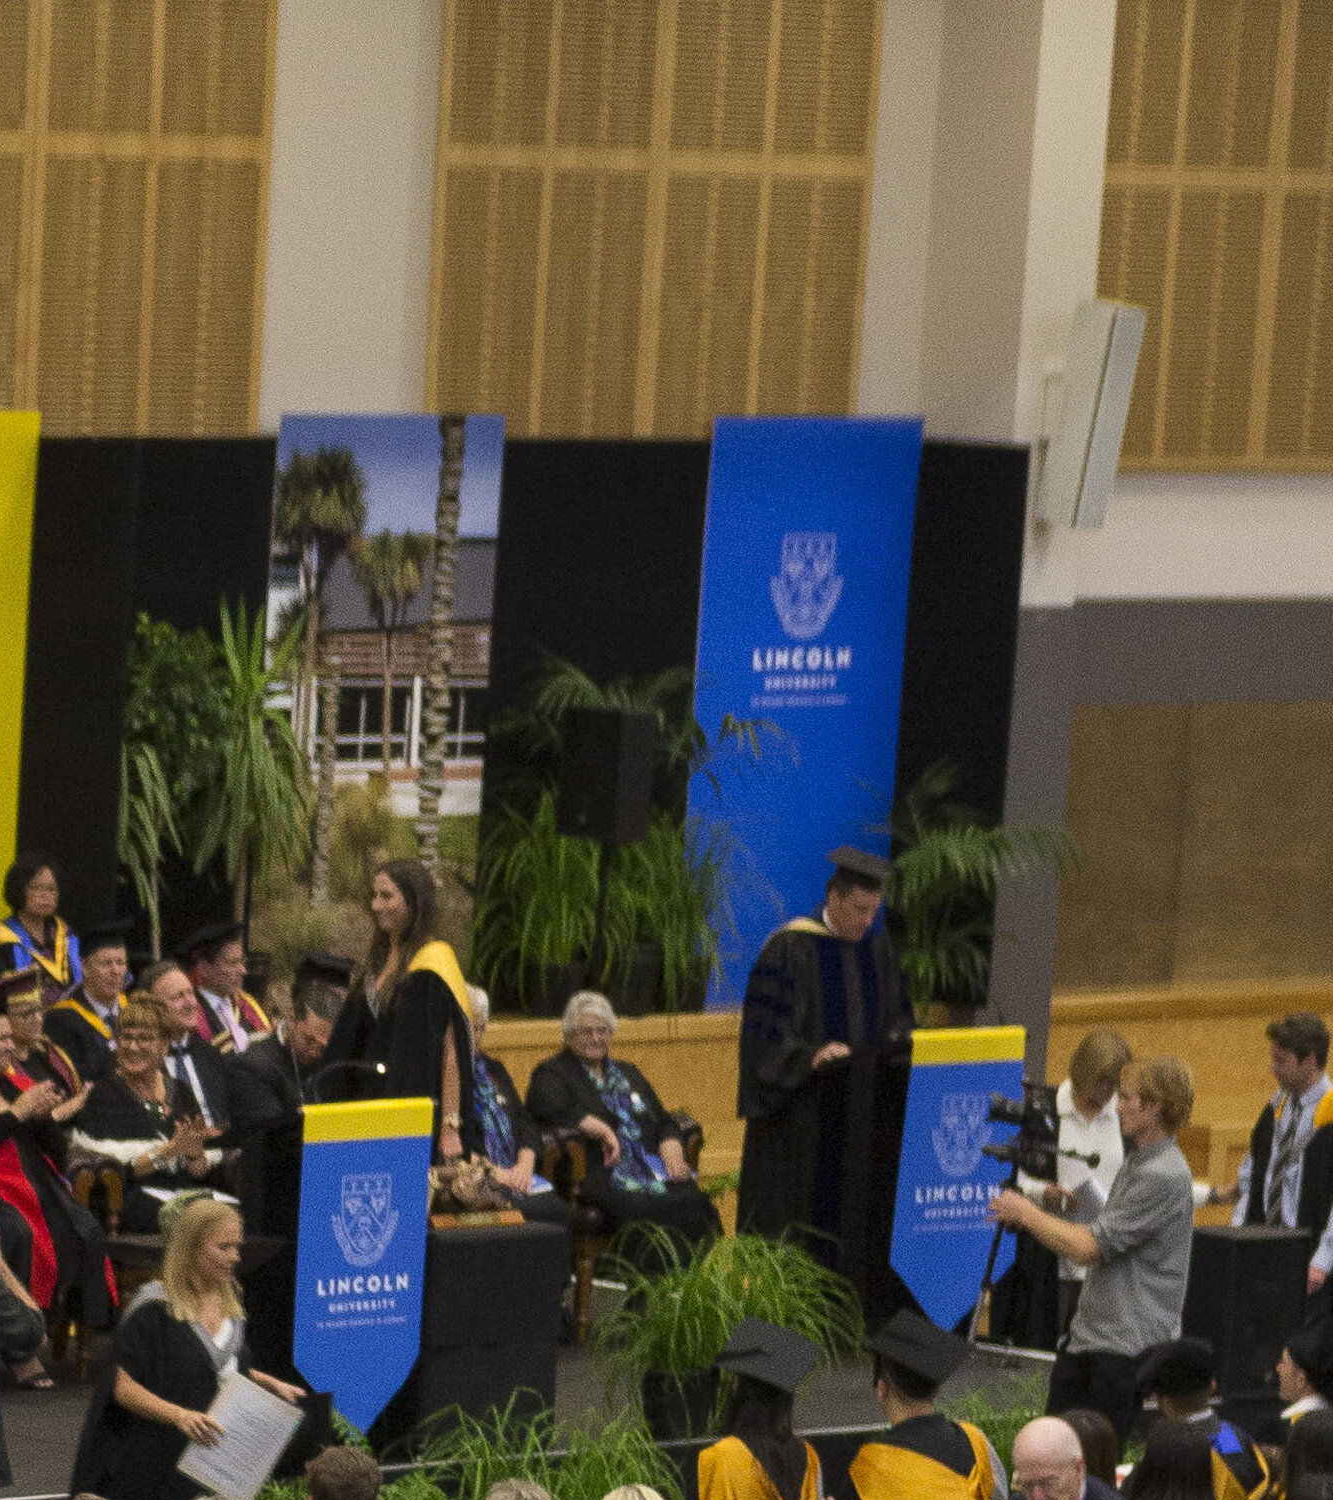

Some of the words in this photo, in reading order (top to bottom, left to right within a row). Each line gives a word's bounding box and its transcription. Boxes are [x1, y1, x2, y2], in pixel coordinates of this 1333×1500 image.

[752, 645, 852, 672] LINCOLN
[915, 1183, 1001, 1204] LINCOLN
[316, 1272, 409, 1298] LINCOLN
